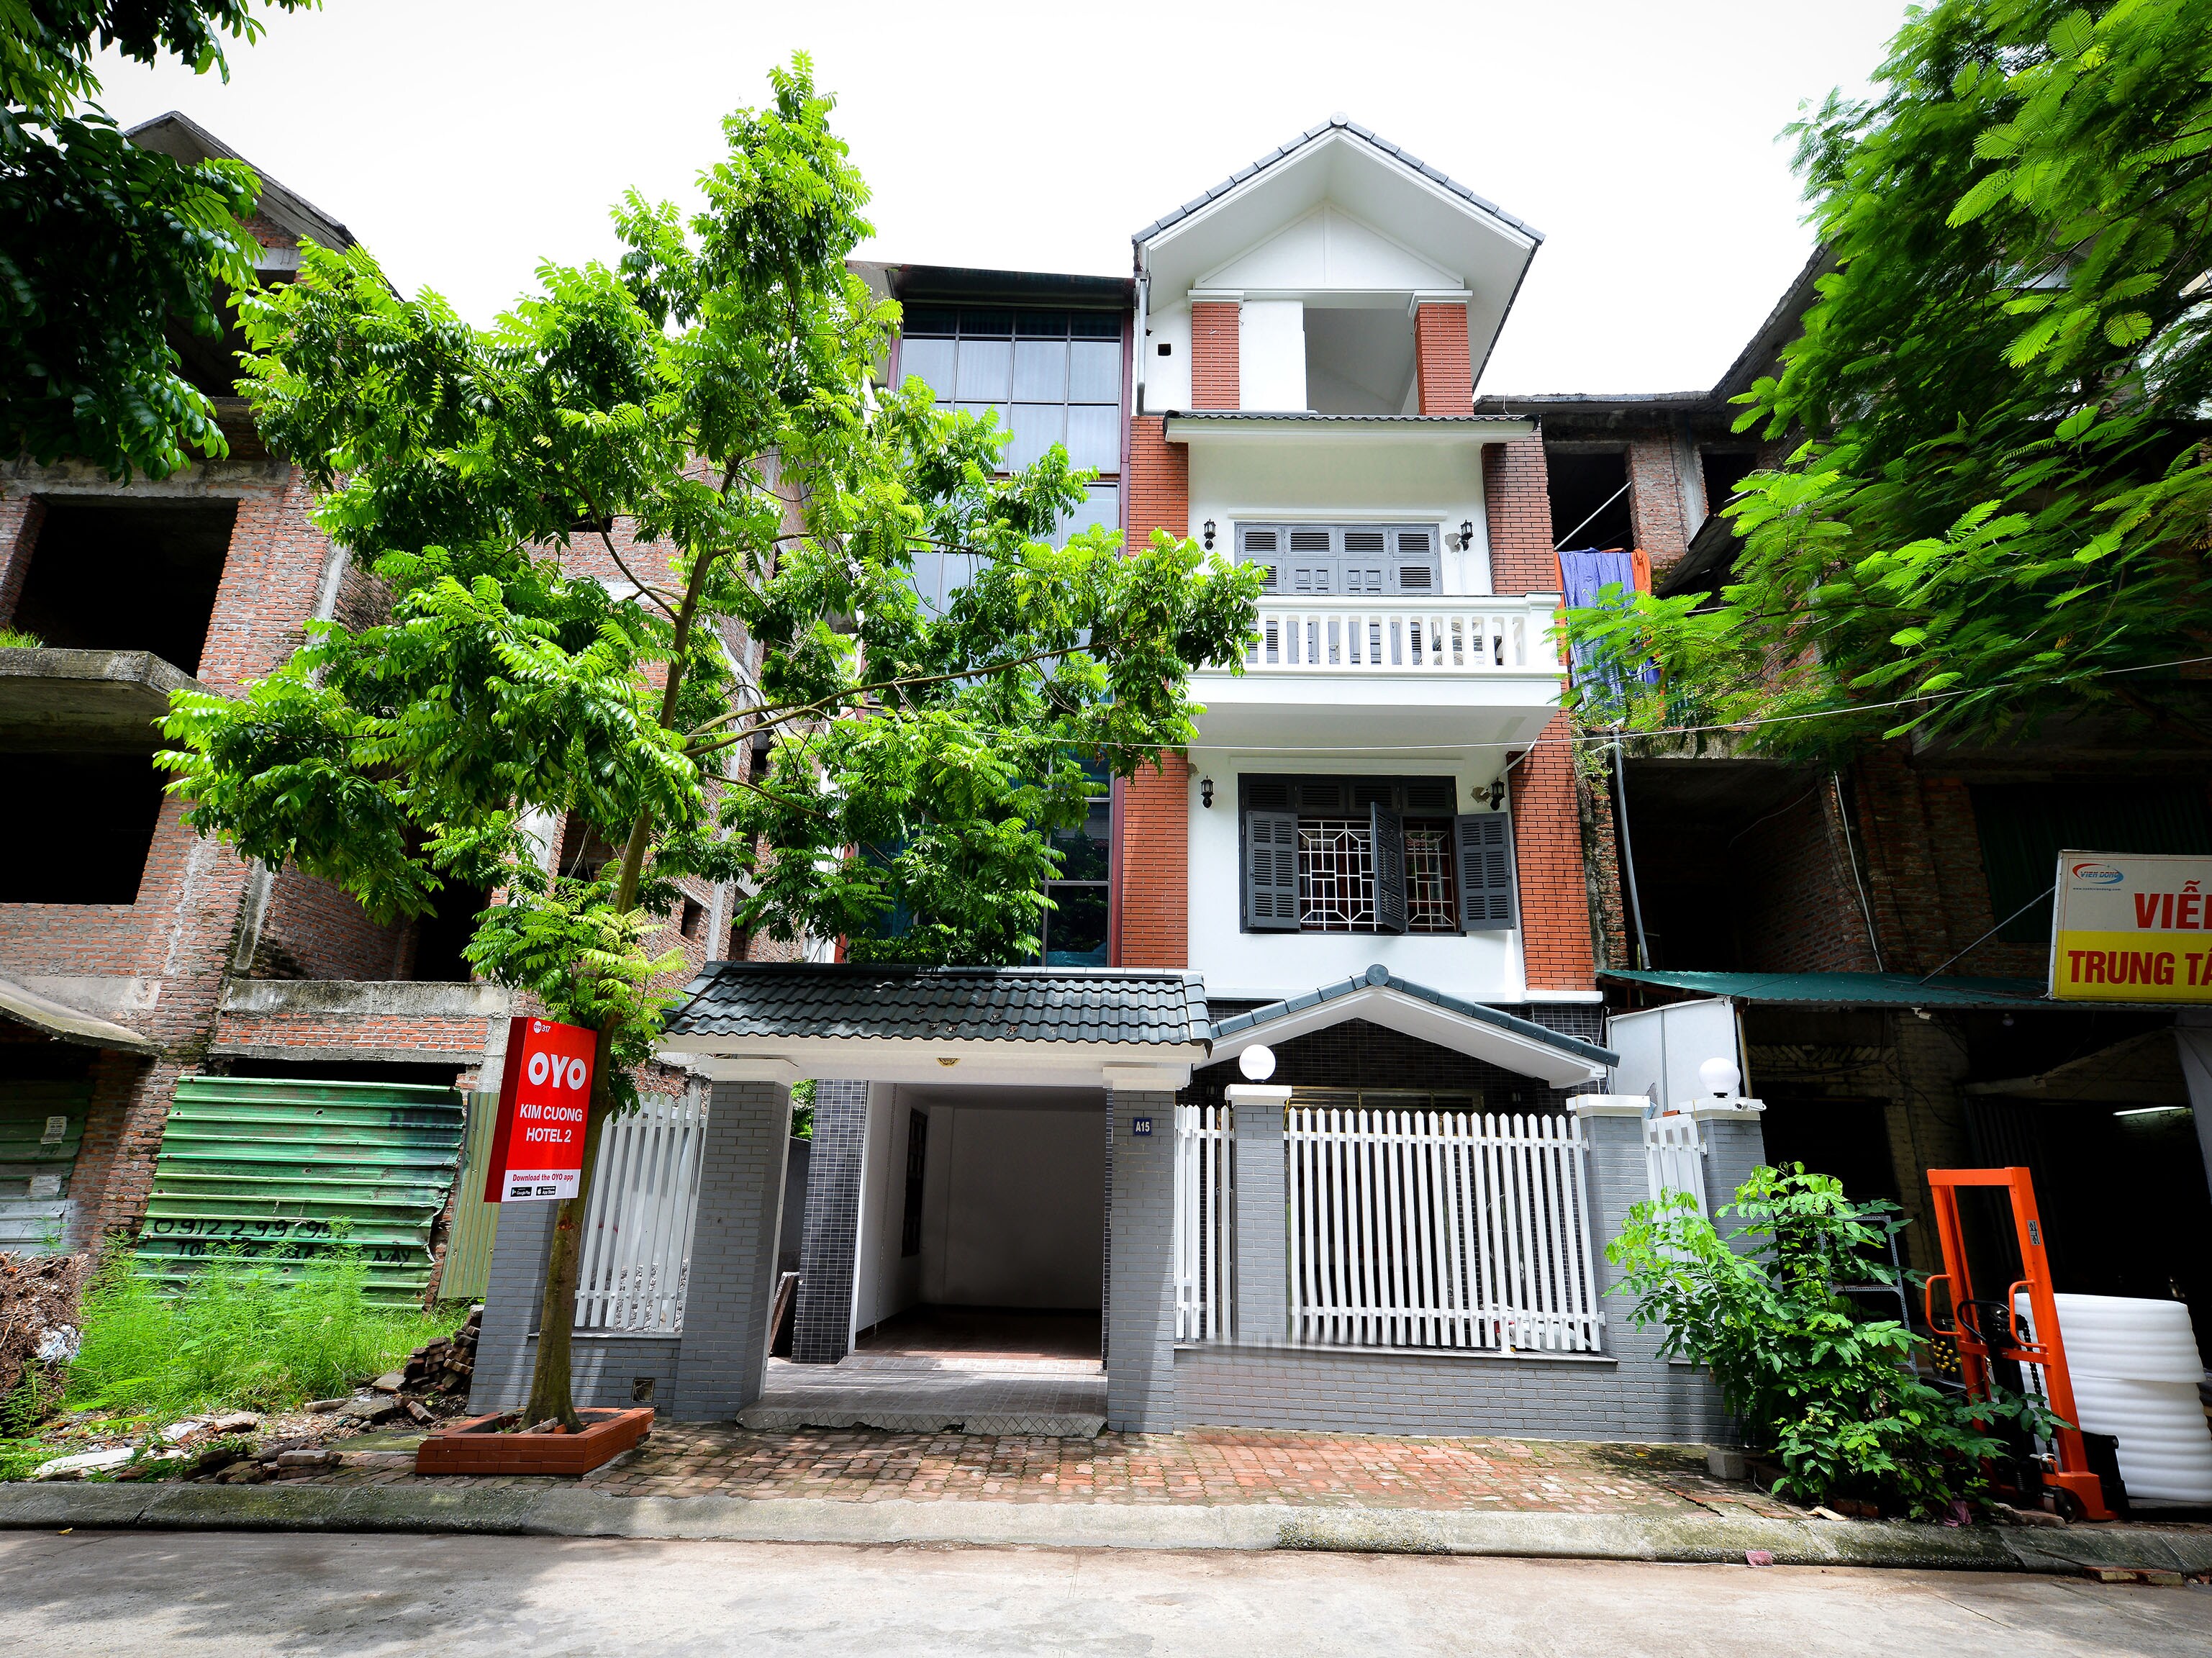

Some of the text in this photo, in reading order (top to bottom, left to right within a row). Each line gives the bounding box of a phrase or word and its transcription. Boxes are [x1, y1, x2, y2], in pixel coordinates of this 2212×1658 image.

[2134, 879, 2212, 930] VIỄ
[2067, 950, 2175, 985] TRUNG
[527, 1051, 586, 1090] OYO
[520, 1104, 583, 1122] KIM CUONG
[526, 1127, 572, 1143] HOTEL 2
[1136, 1121, 1150, 1132] A15
